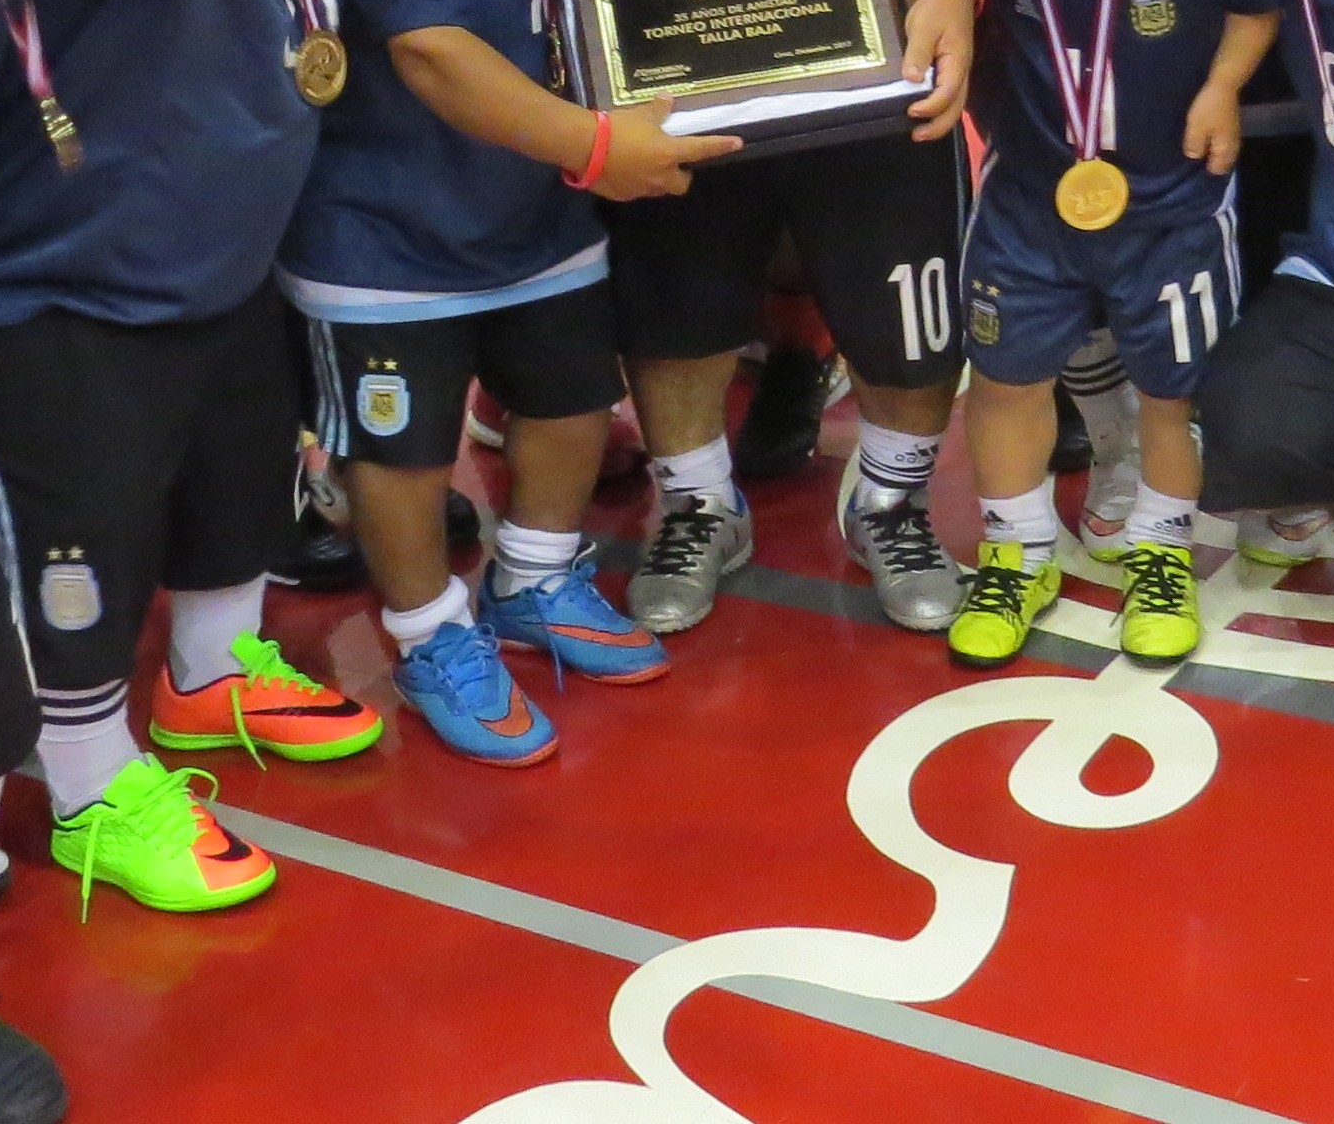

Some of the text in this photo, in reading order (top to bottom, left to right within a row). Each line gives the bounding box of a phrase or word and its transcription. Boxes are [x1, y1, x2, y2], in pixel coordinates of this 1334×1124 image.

[643, 2, 834, 41] TORNEO INTERNACIONAL
[727, 4, 744, 15] DE
[699, 23, 784, 45] TALLA BAJA
[886, 256, 951, 361] 10
[1157, 270, 1218, 364] 11
